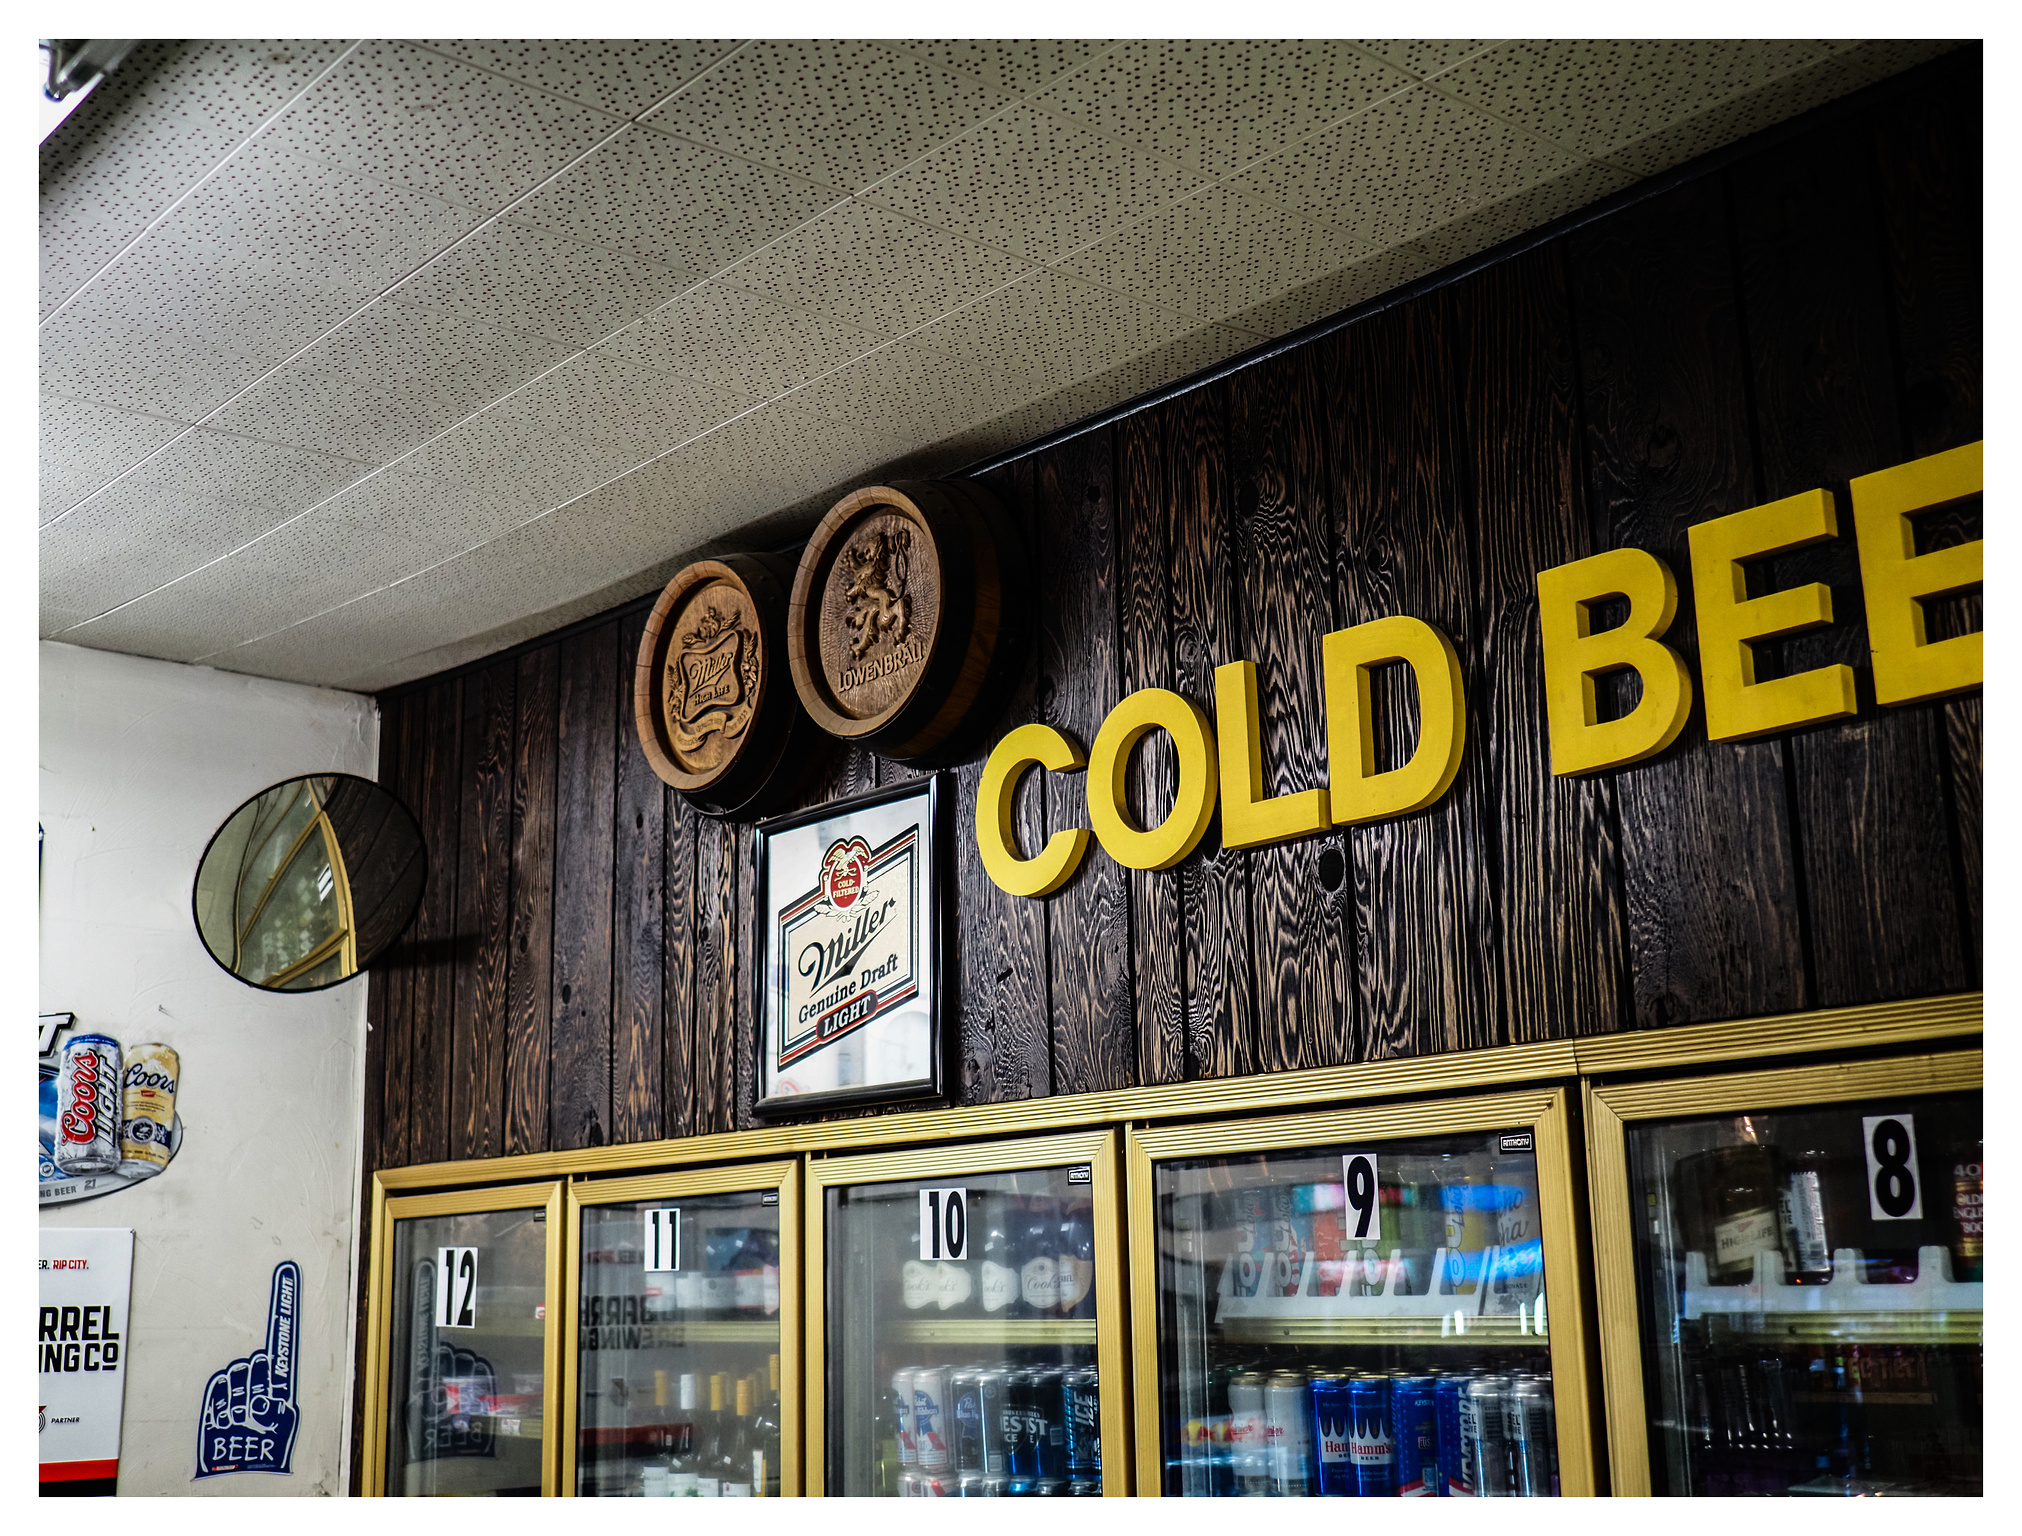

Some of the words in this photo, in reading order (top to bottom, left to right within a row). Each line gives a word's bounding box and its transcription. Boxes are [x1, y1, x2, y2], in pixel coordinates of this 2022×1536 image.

[690, 652, 733, 692] Miller
[975, 615, 1467, 898] COLD
[832, 886, 860, 899] FILTERED
[798, 897, 897, 993] Miller
[798, 981, 857, 1024] Genuine
[860, 953, 898, 990] Draft
[822, 995, 872, 1038] LIGHT
[61, 1048, 99, 1145] Coors
[123, 1063, 175, 1093] Coors
[97, 1053, 118, 1148] LIGHT
[1502, 1137, 1529, 1148] ANTHONY
[1873, 1118, 1916, 1218] 8
[55, 1185, 77, 1197] BEER
[1346, 1155, 1378, 1238] 9
[1956, 1193, 1984, 1206] OLD
[652, 1211, 677, 1270] 11
[928, 1190, 965, 1259] 10
[53, 1260, 67, 1270] RIP
[68, 1260, 89, 1270] CITY.
[280, 1275, 294, 1315] LIGHT
[445, 1250, 476, 1326] 12
[39, 1306, 119, 1341] RREL
[274, 1315, 291, 1377] KEYSTONE
[212, 1436, 275, 1461] BEER
[1351, 1442, 1392, 1456] Hamm's
